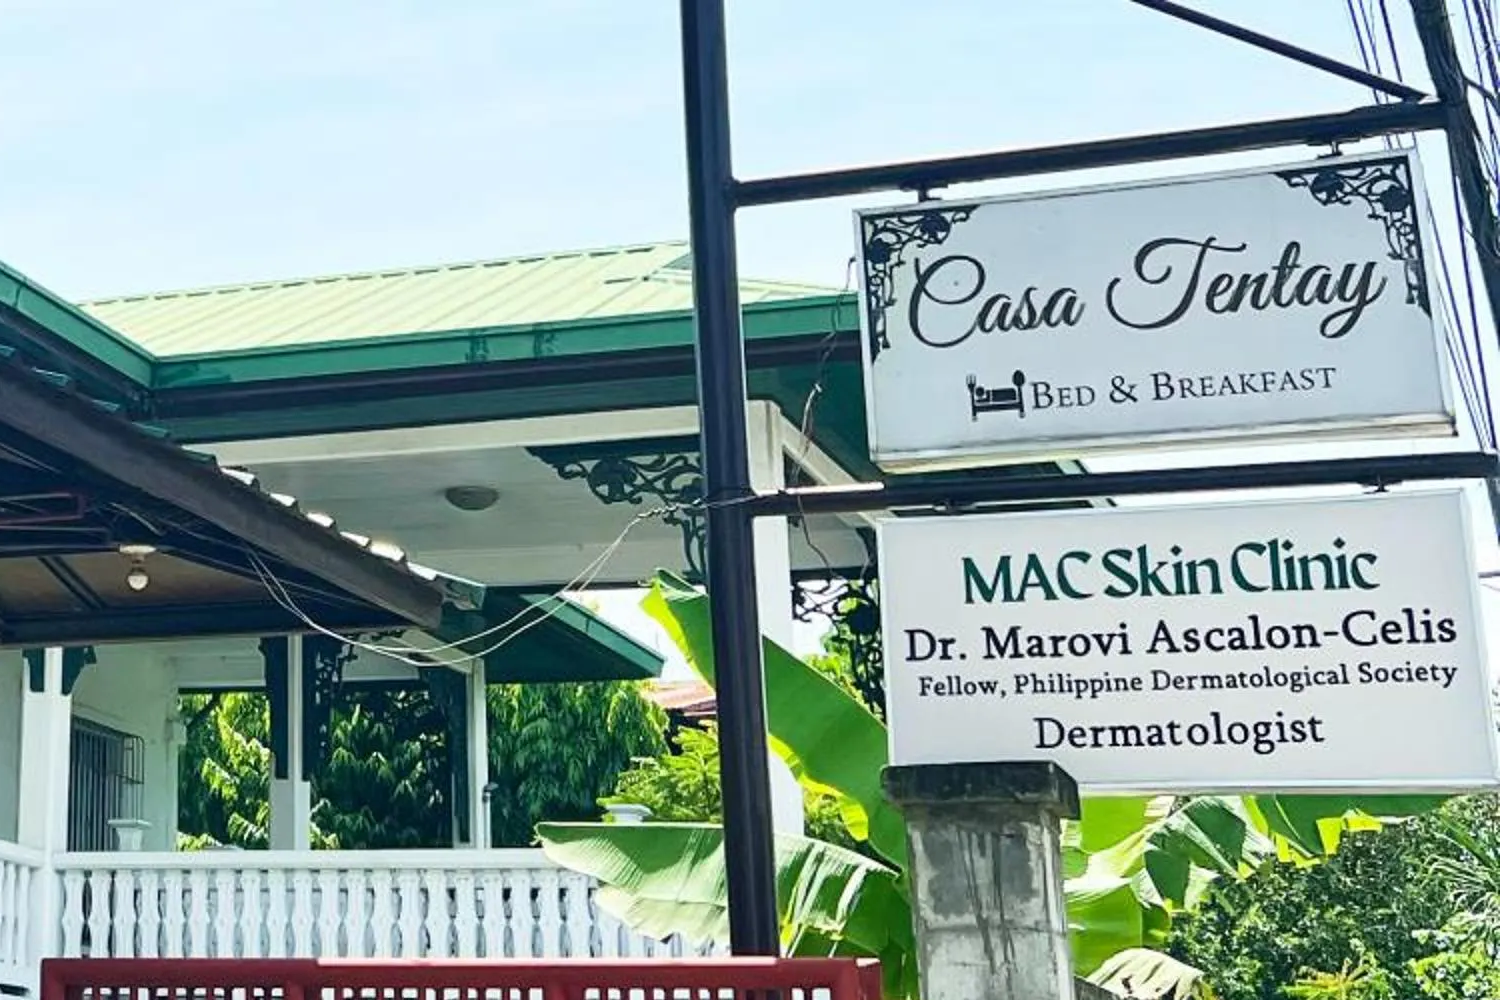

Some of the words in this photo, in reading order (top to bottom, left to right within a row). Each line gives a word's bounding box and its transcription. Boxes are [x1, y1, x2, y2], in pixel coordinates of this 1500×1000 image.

[908, 254, 1085, 349] Casa
[1105, 235, 1388, 339] Tentay
[1109, 376, 1139, 404] &
[961, 550, 1093, 604] MAC
[1102, 543, 1223, 598] Skin
[1231, 537, 1381, 593] Clinic
[904, 628, 967, 662] Dr.
[982, 622, 1133, 660] Marovi
[1146, 608, 1458, 654] Ascalon-Celis
[918, 675, 1007, 698] Fellow,
[1014, 672, 1143, 700] Philippine
[1151, 663, 1350, 693] Dermatological
[1358, 660, 1459, 689] Society
[1033, 711, 1326, 756] Dermatologist
